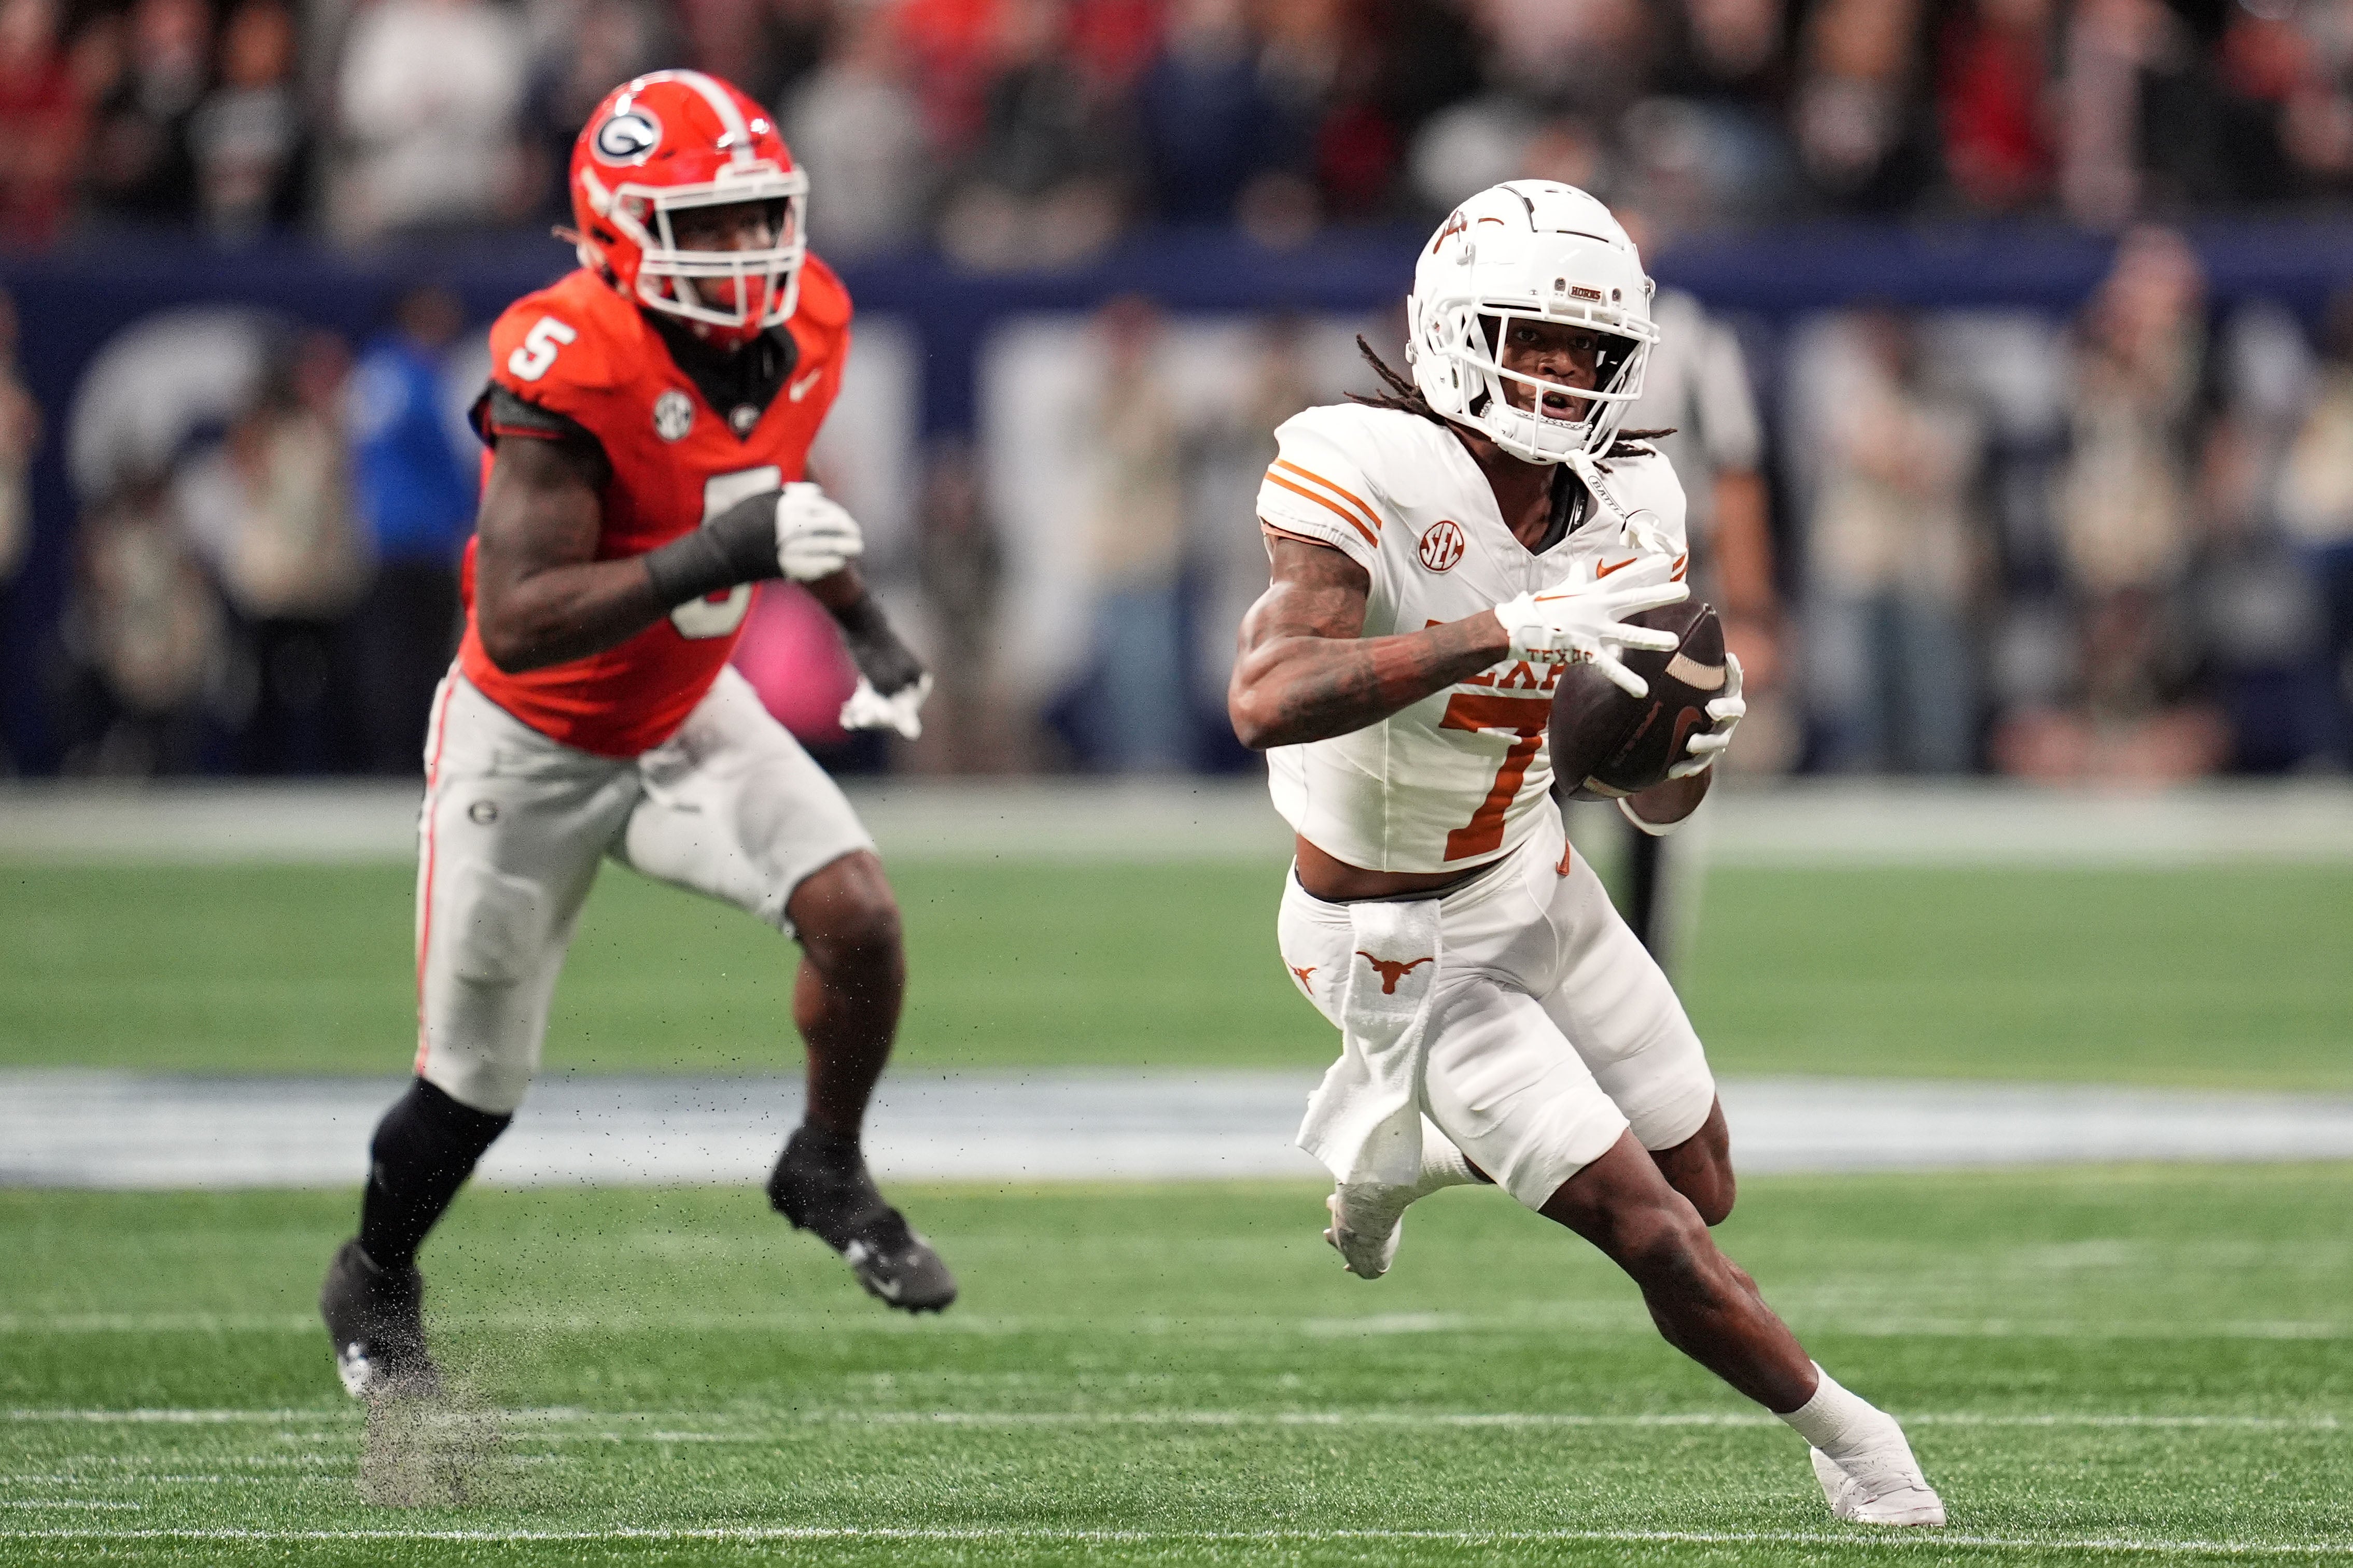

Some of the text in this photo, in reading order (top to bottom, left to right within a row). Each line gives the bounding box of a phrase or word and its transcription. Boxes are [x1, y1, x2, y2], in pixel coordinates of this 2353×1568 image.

[1571, 286, 1601, 300] HORNS
[508, 316, 578, 382] 5
[1420, 521, 1464, 570] SEC
[1438, 693, 1553, 862] 7
